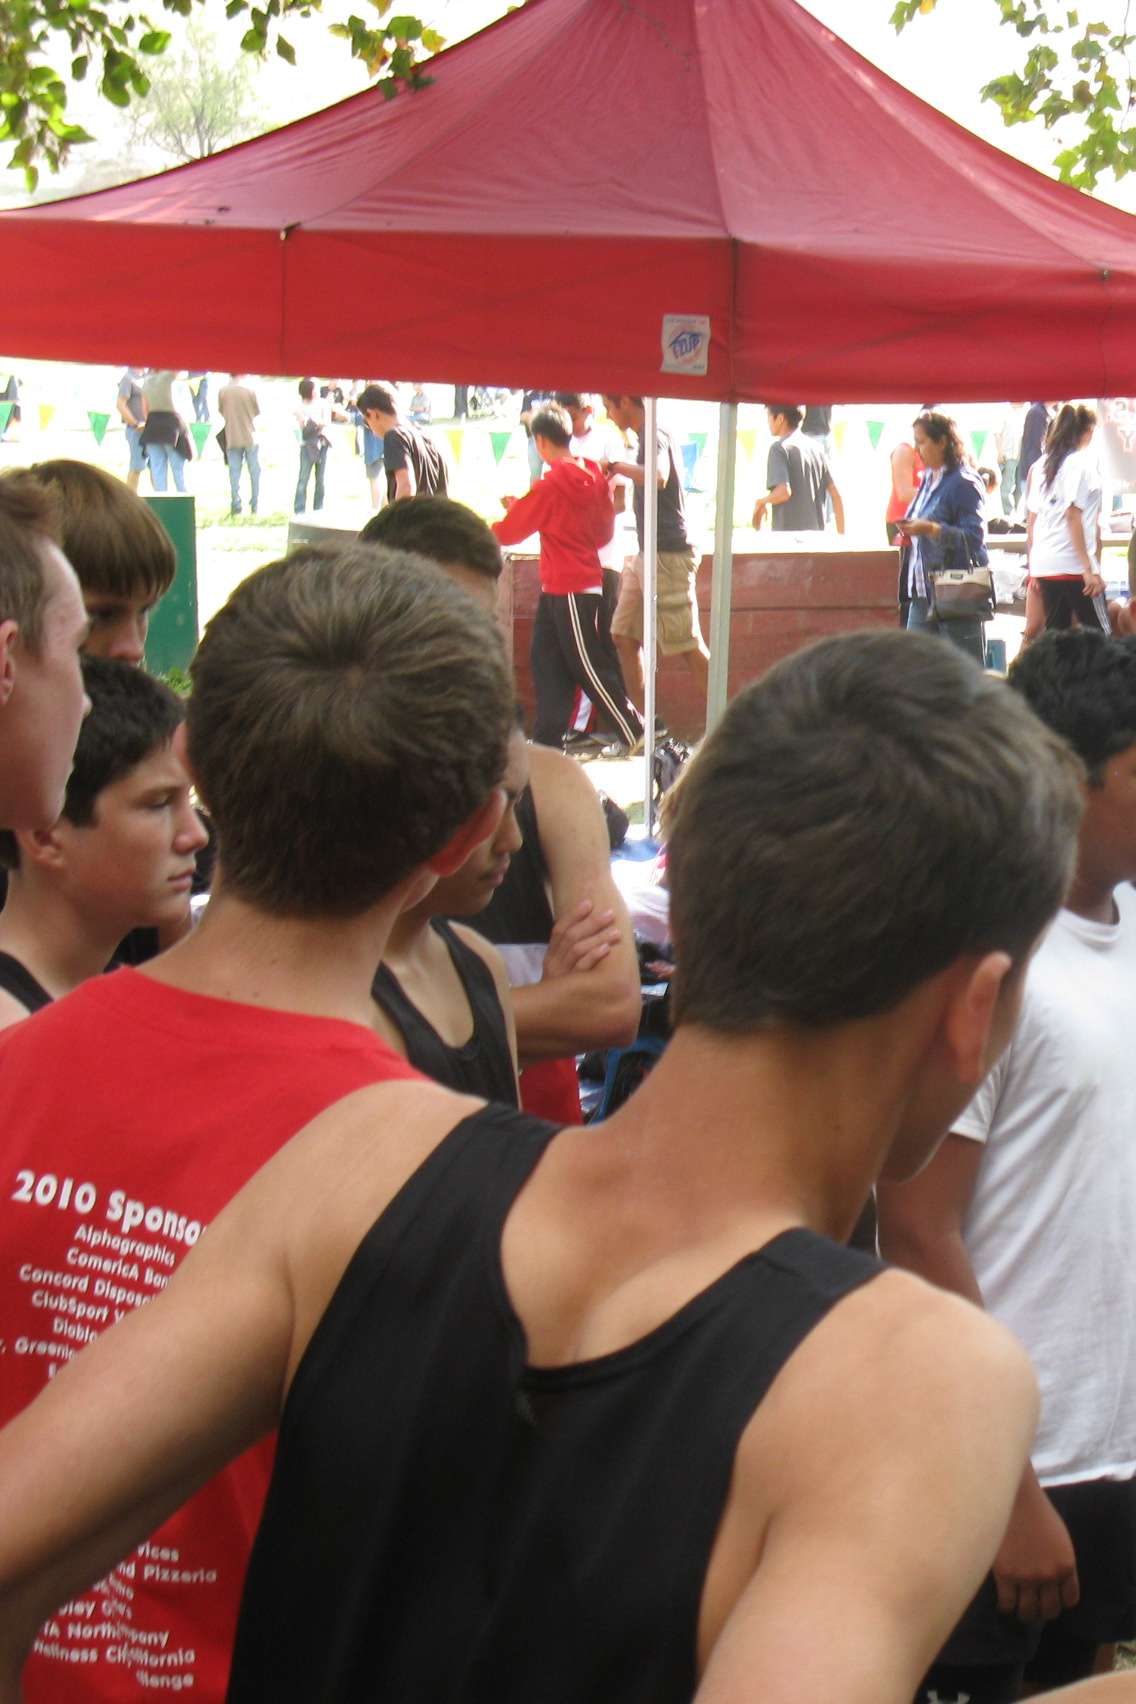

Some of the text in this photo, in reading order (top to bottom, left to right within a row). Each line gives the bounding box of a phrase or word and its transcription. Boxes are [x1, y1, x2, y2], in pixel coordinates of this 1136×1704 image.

[11, 1169, 97, 1214] 2010
[74, 1224, 176, 1268] Alphagraphics
[19, 1263, 89, 1293] Concord
[144, 1268, 173, 1290] Ban
[31, 1290, 109, 1322] ClubSport
[137, 1541, 180, 1562] vices
[117, 1561, 218, 1584] nd Pizzeria
